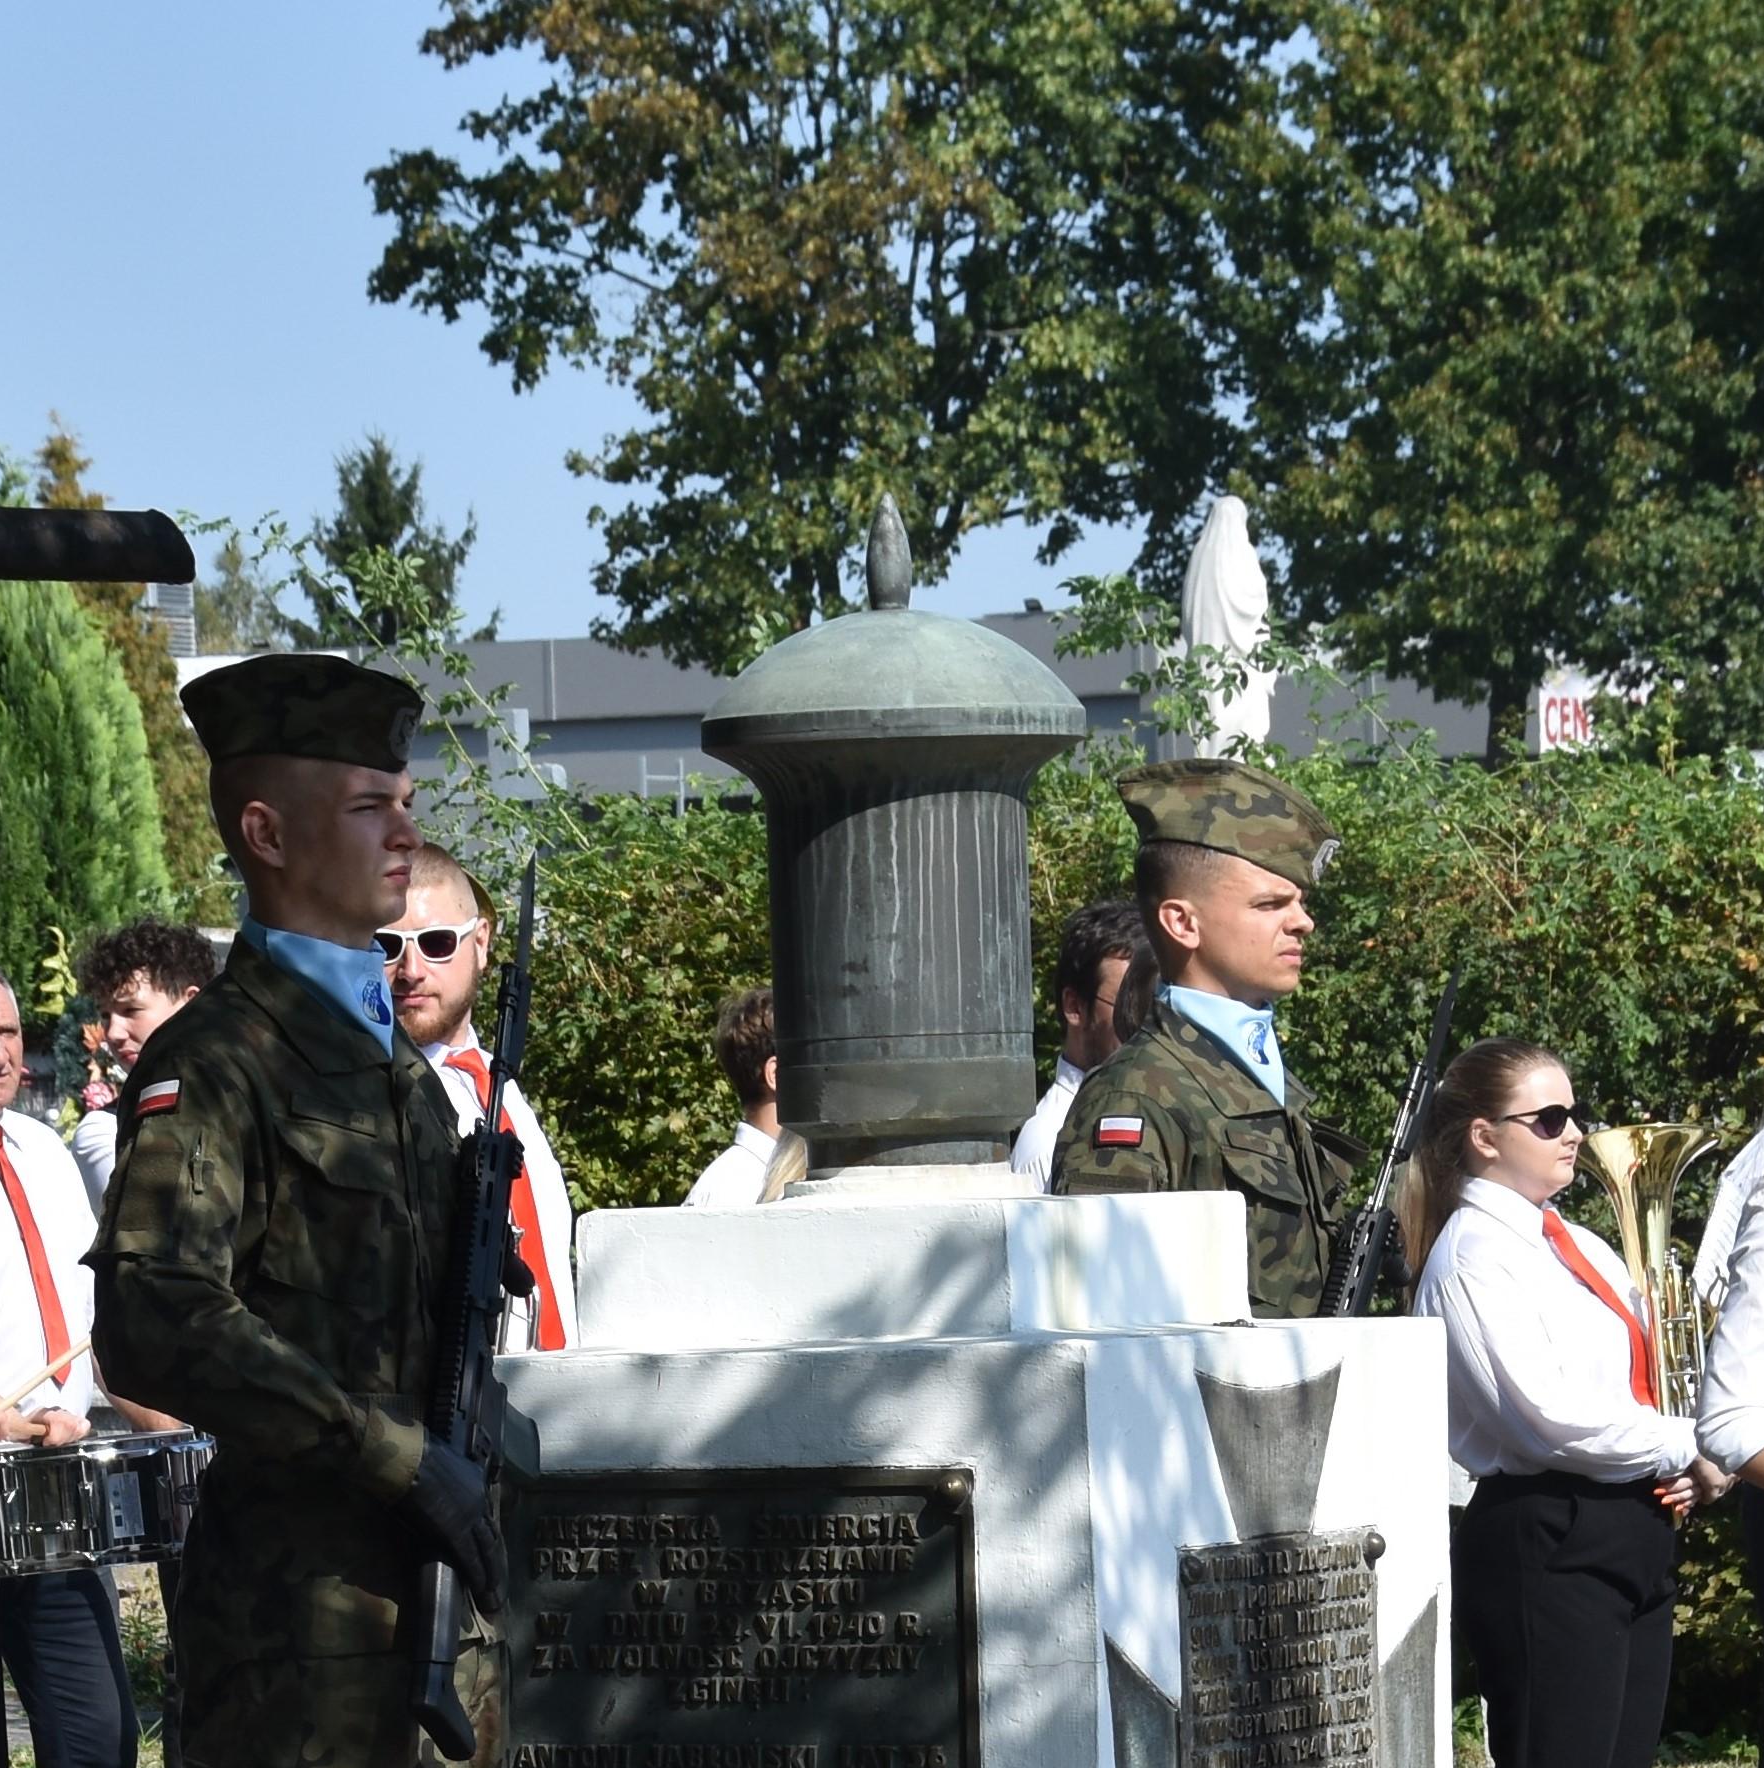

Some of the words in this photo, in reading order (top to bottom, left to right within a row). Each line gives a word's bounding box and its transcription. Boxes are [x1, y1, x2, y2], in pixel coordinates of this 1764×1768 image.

[535, 1548, 642, 1578] PRZEZ
[662, 1547, 915, 1576] ROZSTRZELANIE
[635, 1580, 670, 1608] W
[700, 1579, 865, 1610] BRZASKU
[536, 1613, 570, 1640] W
[608, 1613, 686, 1640] DNIU
[896, 1612, 932, 1638] R.
[533, 1646, 579, 1675] ZA
[758, 1646, 926, 1674] OJCZYZNY
